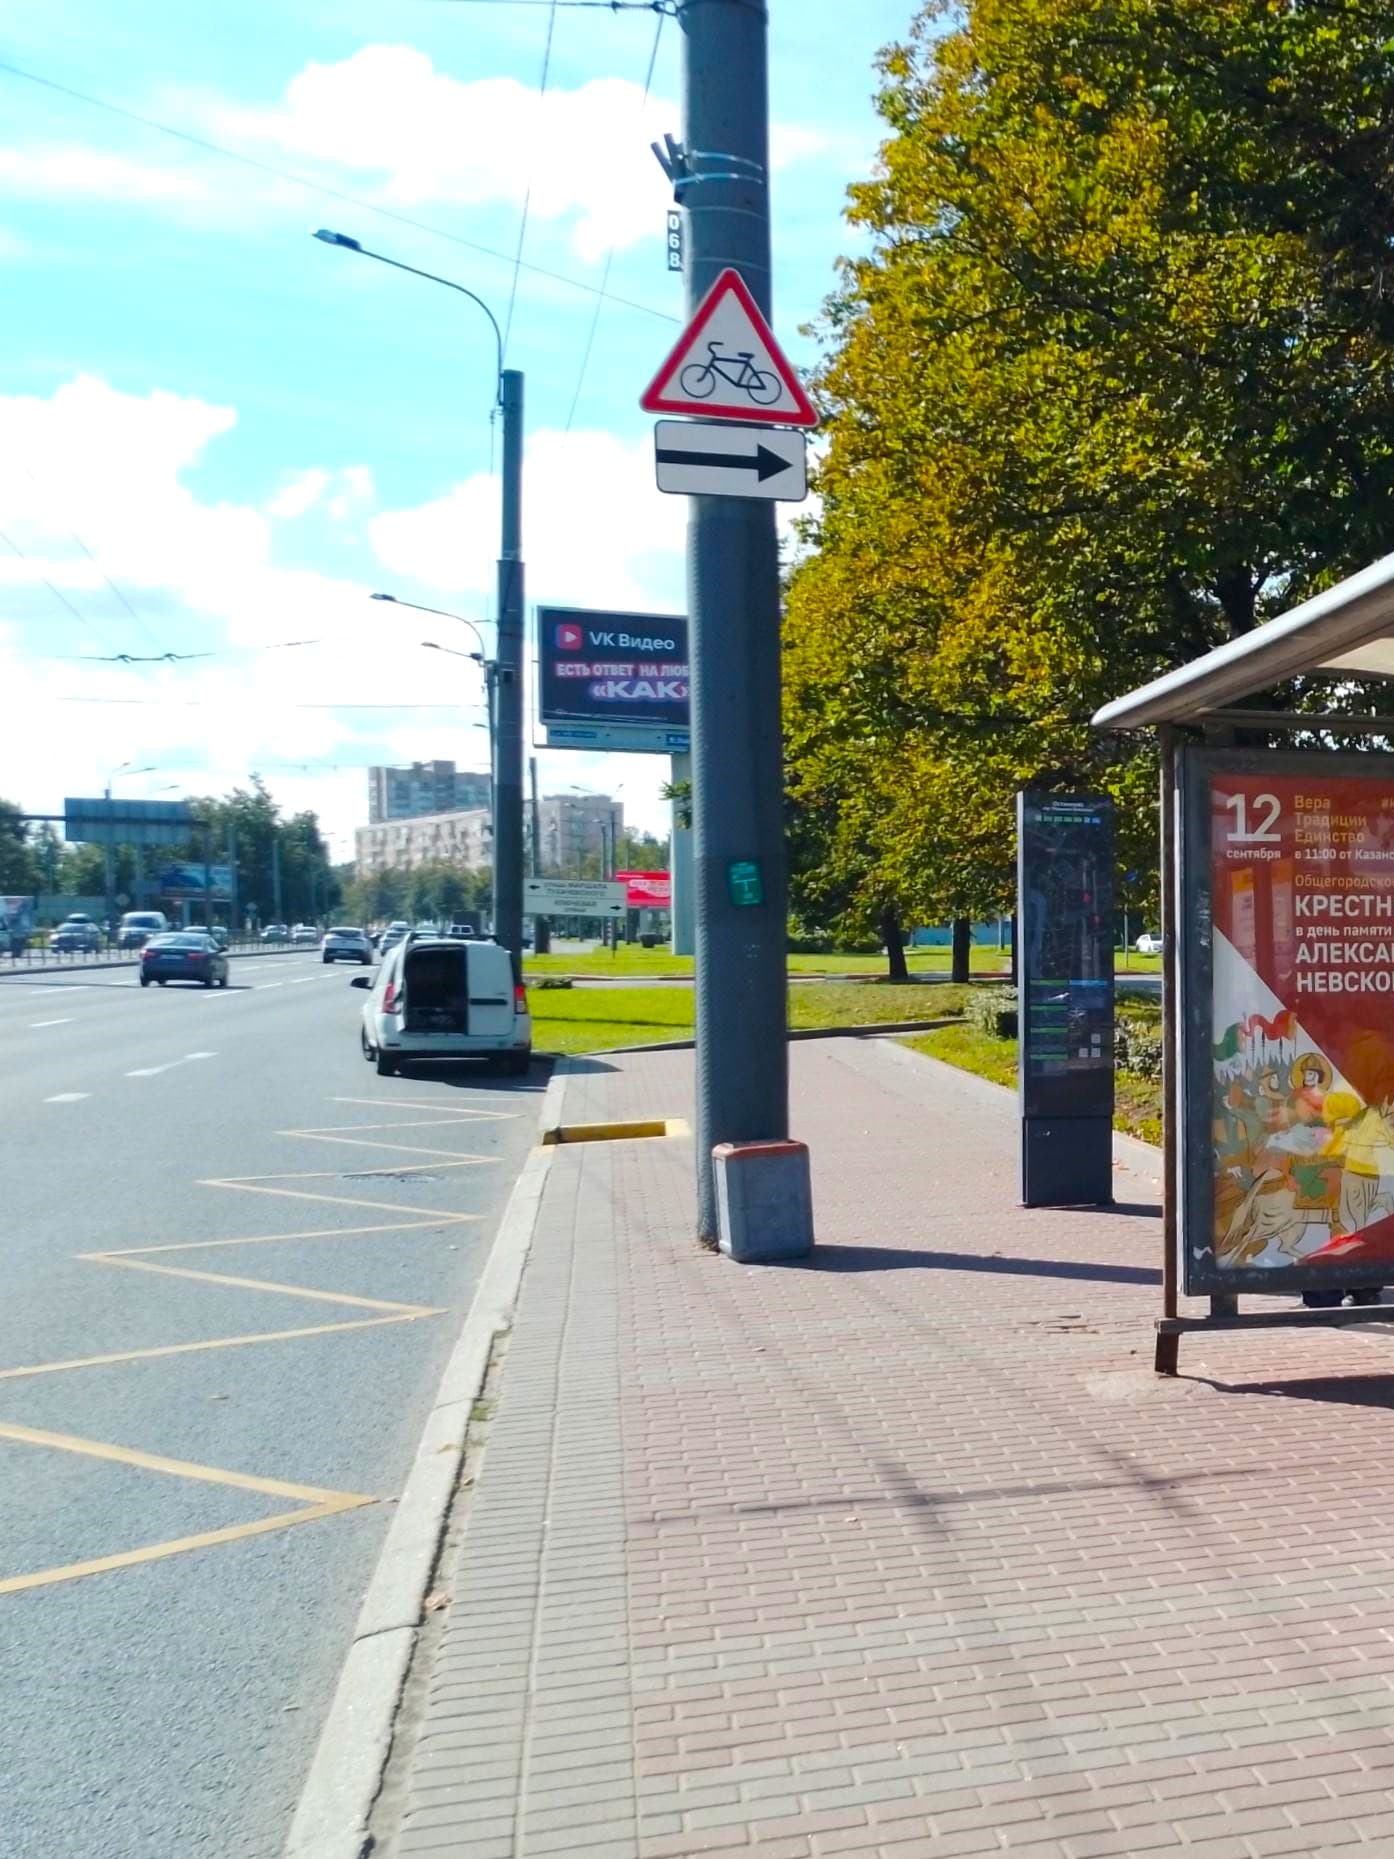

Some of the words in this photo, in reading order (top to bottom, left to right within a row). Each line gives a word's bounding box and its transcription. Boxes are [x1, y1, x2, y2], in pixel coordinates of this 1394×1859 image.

[669, 214, 681, 268] 068
[589, 631, 616, 647] VK
[619, 633, 675, 651] Видео
[556, 663, 590, 676] ЕСТЬ
[593, 664, 634, 677] ОТВЕТ
[639, 664, 657, 677] НА
[1294, 795, 1331, 812] Вера
[1226, 793, 1281, 842] 12
[1294, 812, 1367, 828] Традиции
[1294, 829, 1366, 844] Единство
[1226, 848, 1281, 861] сентября
[1294, 852, 1301, 860] в
[1305, 849, 1337, 860] 11:00
[1339, 852, 1351, 860] от
[1296, 926, 1304, 936] в
[1307, 925, 1340, 938] день
[1343, 926, 1393, 937] памяти
